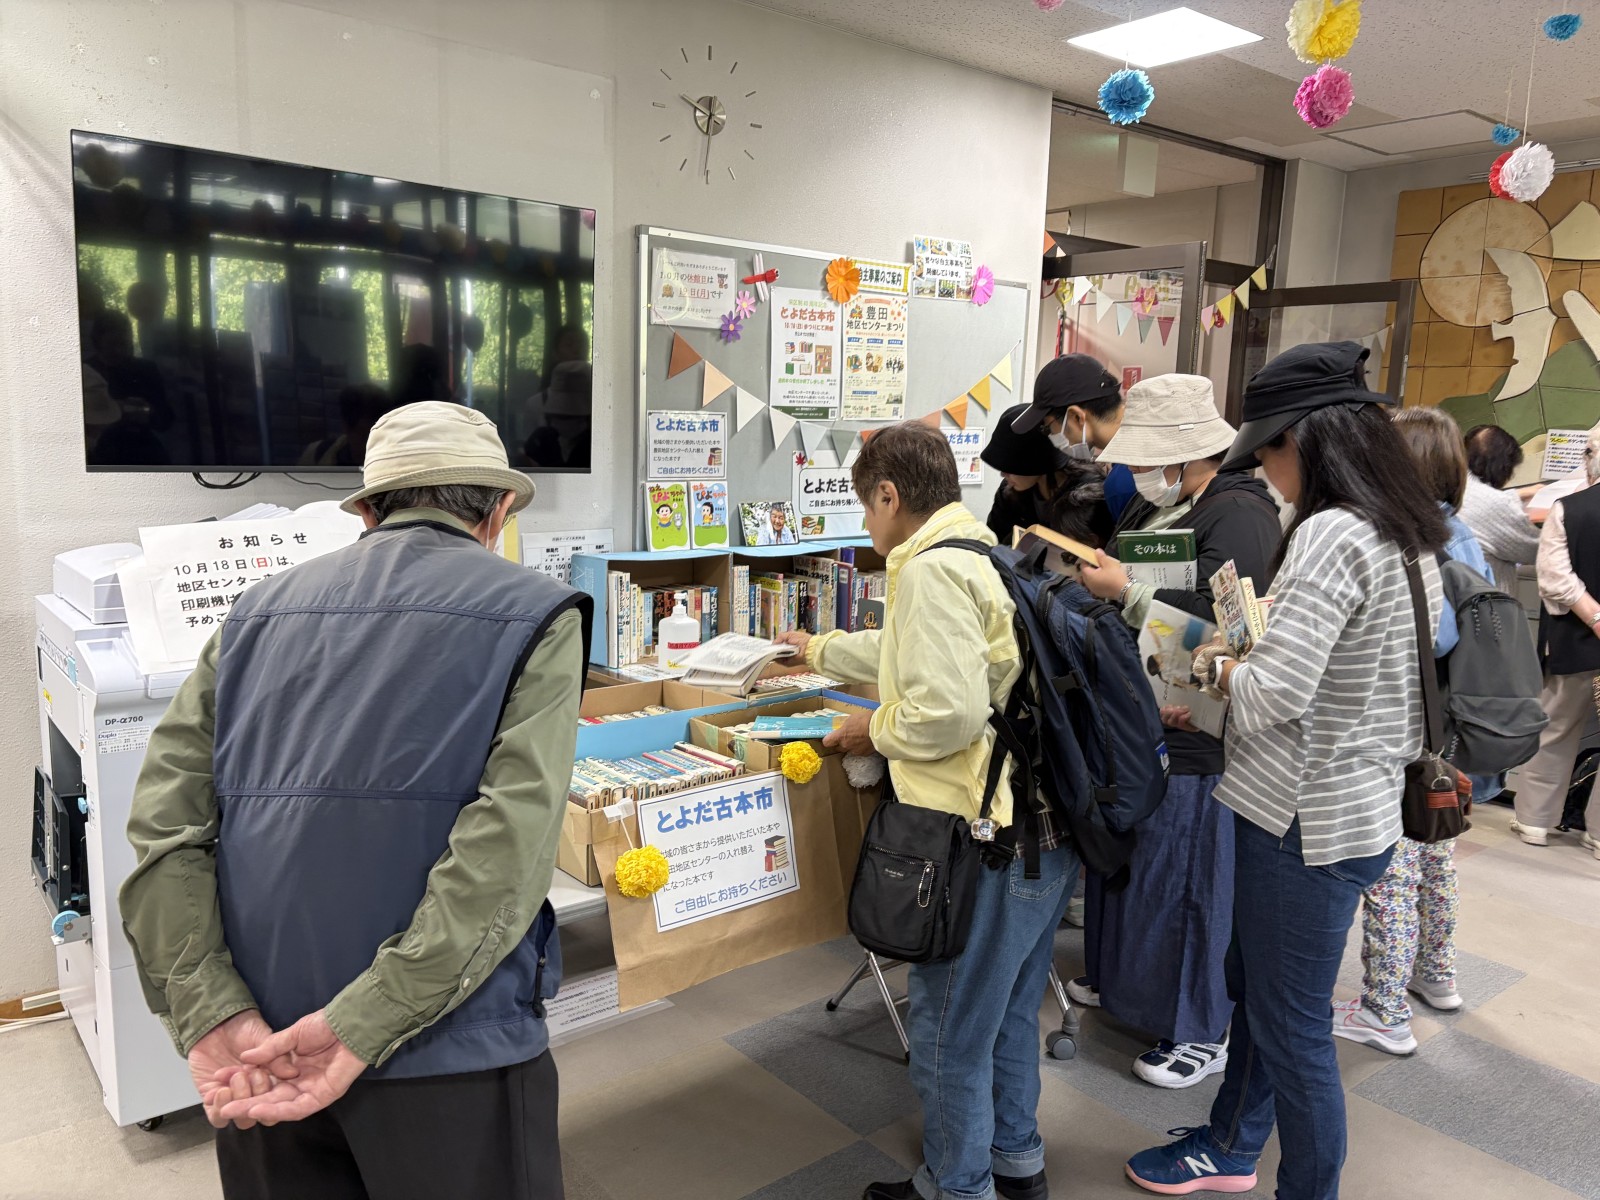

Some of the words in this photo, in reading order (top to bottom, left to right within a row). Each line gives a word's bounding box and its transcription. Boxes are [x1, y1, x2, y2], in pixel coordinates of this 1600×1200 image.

[780, 306, 836, 323] とよだ古本市
[866, 305, 888, 321] 豊田
[846, 318, 904, 332] 地区センターまつり
[655, 418, 720, 433] とよだ古本市
[947, 433, 980, 445] だ古本市
[657, 467, 720, 475] ご自由にお持ちください
[218, 533, 307, 549] お知らせ
[1133, 542, 1177, 555] その本は
[173, 556, 295, 576] 10月18日(日)は、
[657, 787, 773, 833] とよだ古本市
[674, 872, 787, 914] ご自由にお持ちください
